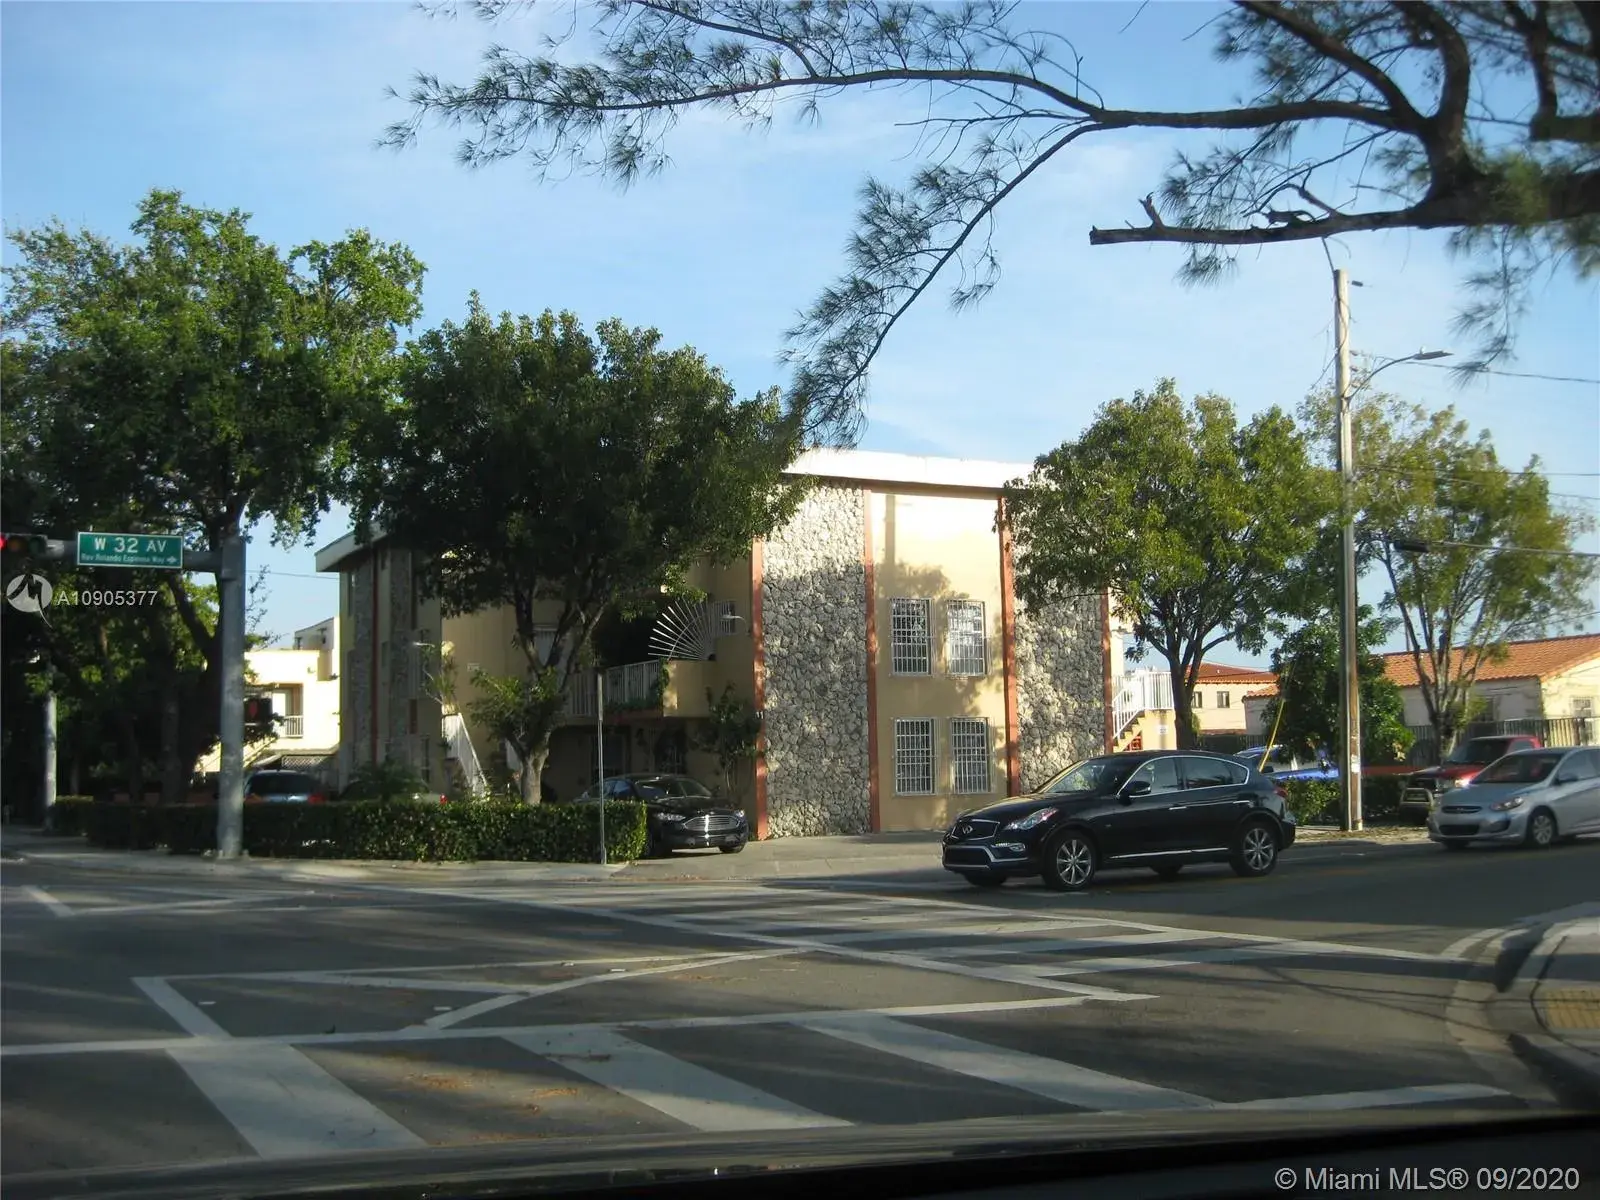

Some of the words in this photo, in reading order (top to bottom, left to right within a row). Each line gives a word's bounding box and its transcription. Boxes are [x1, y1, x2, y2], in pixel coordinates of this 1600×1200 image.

[95, 537, 106, 551] W
[114, 536, 138, 553] 32
[146, 540, 167, 553] AV
